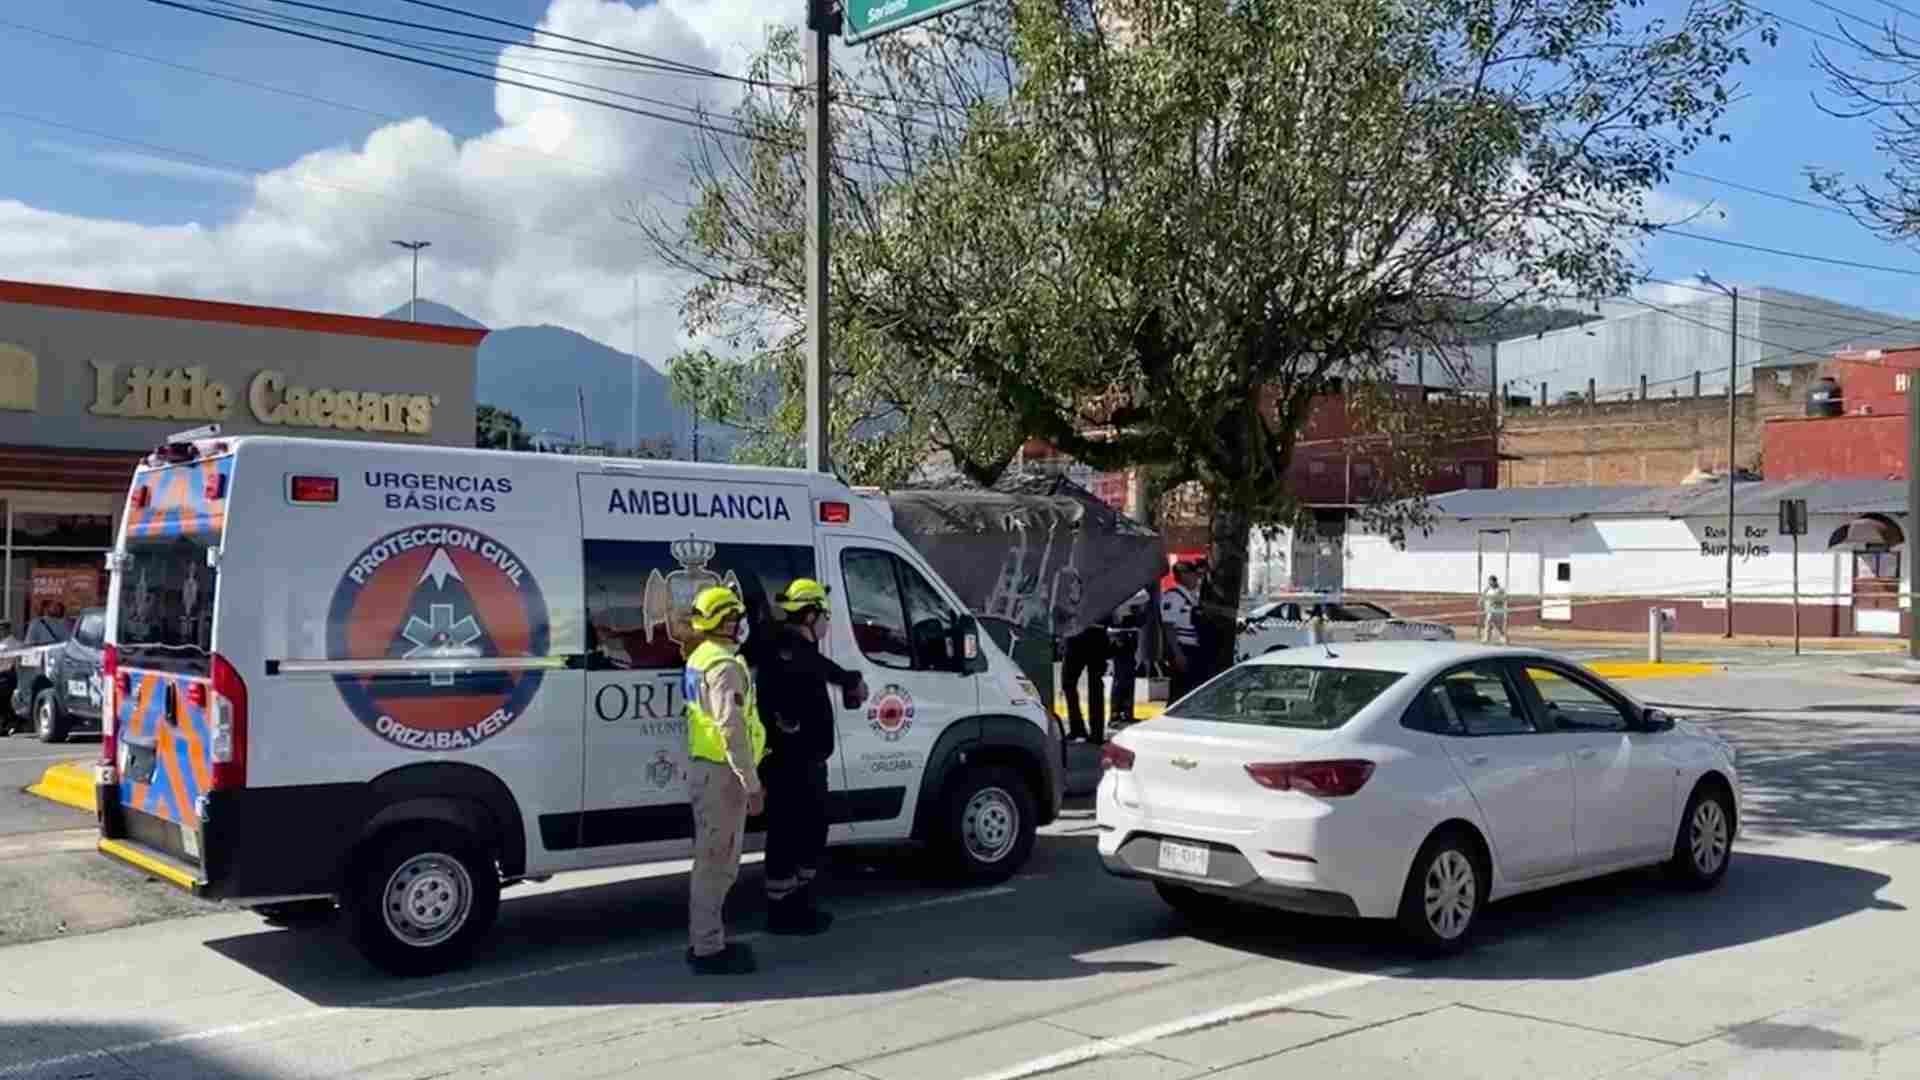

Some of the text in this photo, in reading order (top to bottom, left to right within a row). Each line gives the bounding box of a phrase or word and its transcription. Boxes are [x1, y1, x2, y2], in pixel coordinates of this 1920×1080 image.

[90, 360, 436, 434] Little Caesars
[365, 471, 513, 493] URGENCIAS
[385, 491, 497, 512] BÁSICAS
[608, 487, 792, 521] AMBULANCIA
[350, 528, 524, 587] PROTECCION CIVIL
